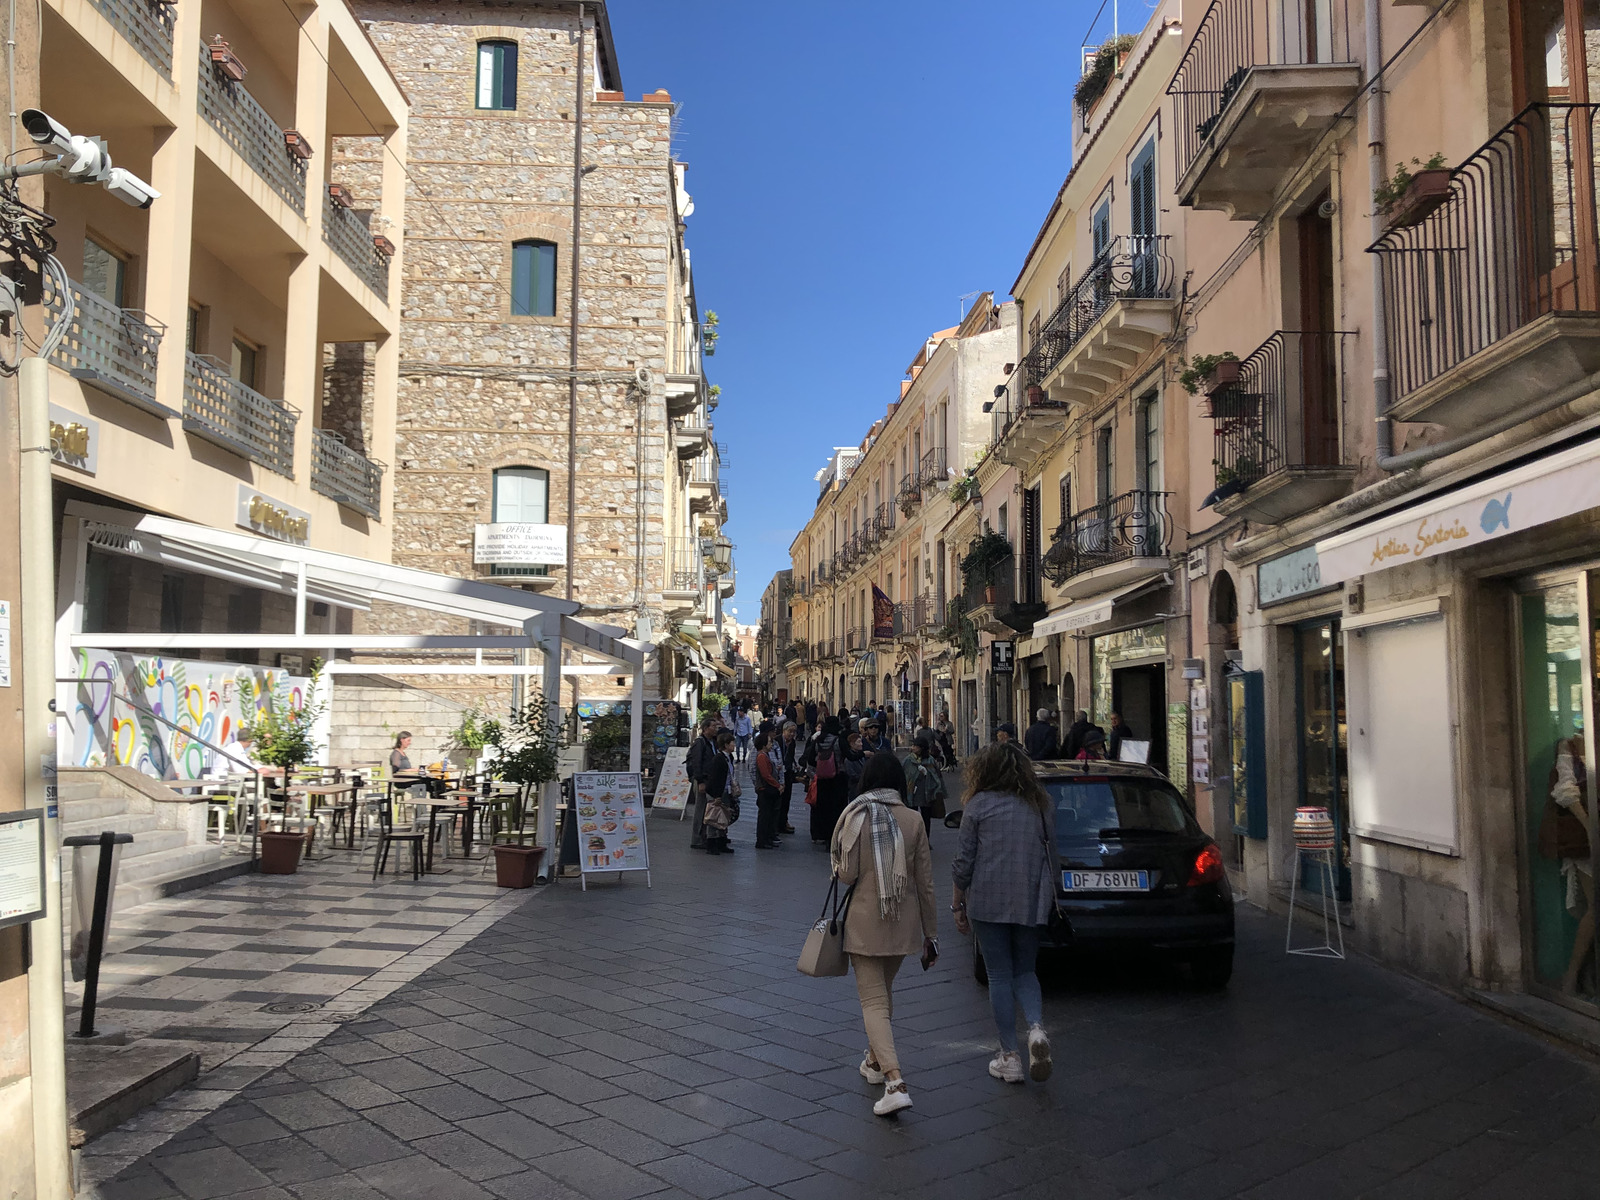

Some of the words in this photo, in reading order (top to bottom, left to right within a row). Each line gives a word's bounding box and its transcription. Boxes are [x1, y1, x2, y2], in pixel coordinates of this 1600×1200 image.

[1414, 518, 1470, 556] Sartoria
[995, 642, 1010, 662] T
[1073, 873, 1089, 887] DF
[1094, 873, 1139, 887] 768VH
